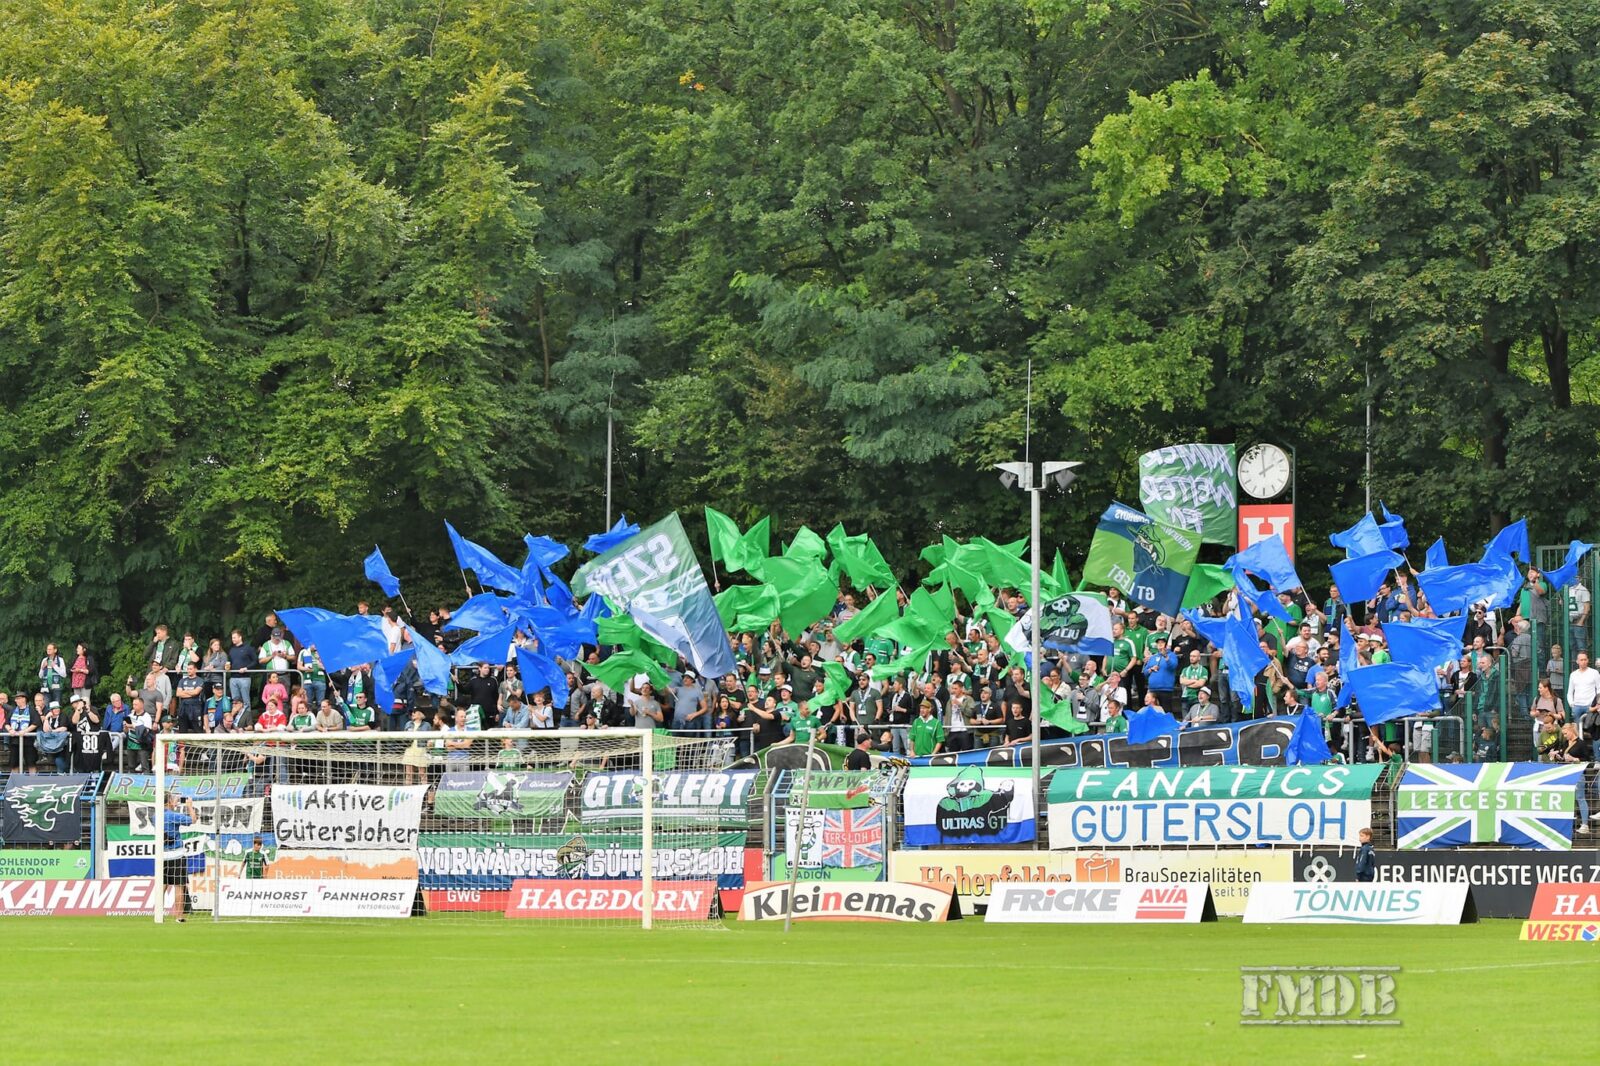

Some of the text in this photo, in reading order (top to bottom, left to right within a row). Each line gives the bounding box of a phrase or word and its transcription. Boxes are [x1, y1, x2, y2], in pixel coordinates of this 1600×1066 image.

[82, 735, 98, 750] 80
[114, 776, 242, 795] RHEDA
[583, 773, 756, 808] GT LEBT
[1076, 767, 1350, 799] FANATICS
[304, 789, 385, 811] Aktive
[1411, 791, 1562, 810] LEICESTER
[276, 818, 418, 843] Gütersloher
[942, 815, 1008, 830] ULTRAS GT
[1072, 802, 1346, 842] GÜTERSLOH
[116, 840, 200, 856] ISSELST
[418, 842, 744, 877] VORWÄRTS GÜTERSLOH
[0, 867, 43, 876] STADION
[785, 871, 831, 879] SADION
[1125, 866, 1261, 882] BrauSpezialitäten
[1411, 865, 1531, 885] EINFACHSTE
[1536, 865, 1583, 883] WEG
[0, 881, 175, 909] KAHMEN
[226, 891, 308, 900] PANNHORST
[322, 892, 405, 901] PANNHORST
[447, 890, 481, 902] GWG
[516, 889, 704, 912] HAGEDORN
[1215, 887, 1235, 897] seit
[1293, 885, 1421, 912] TÖNNIES
[753, 885, 936, 921] Kleinemas
[1528, 924, 1582, 940] WEST
